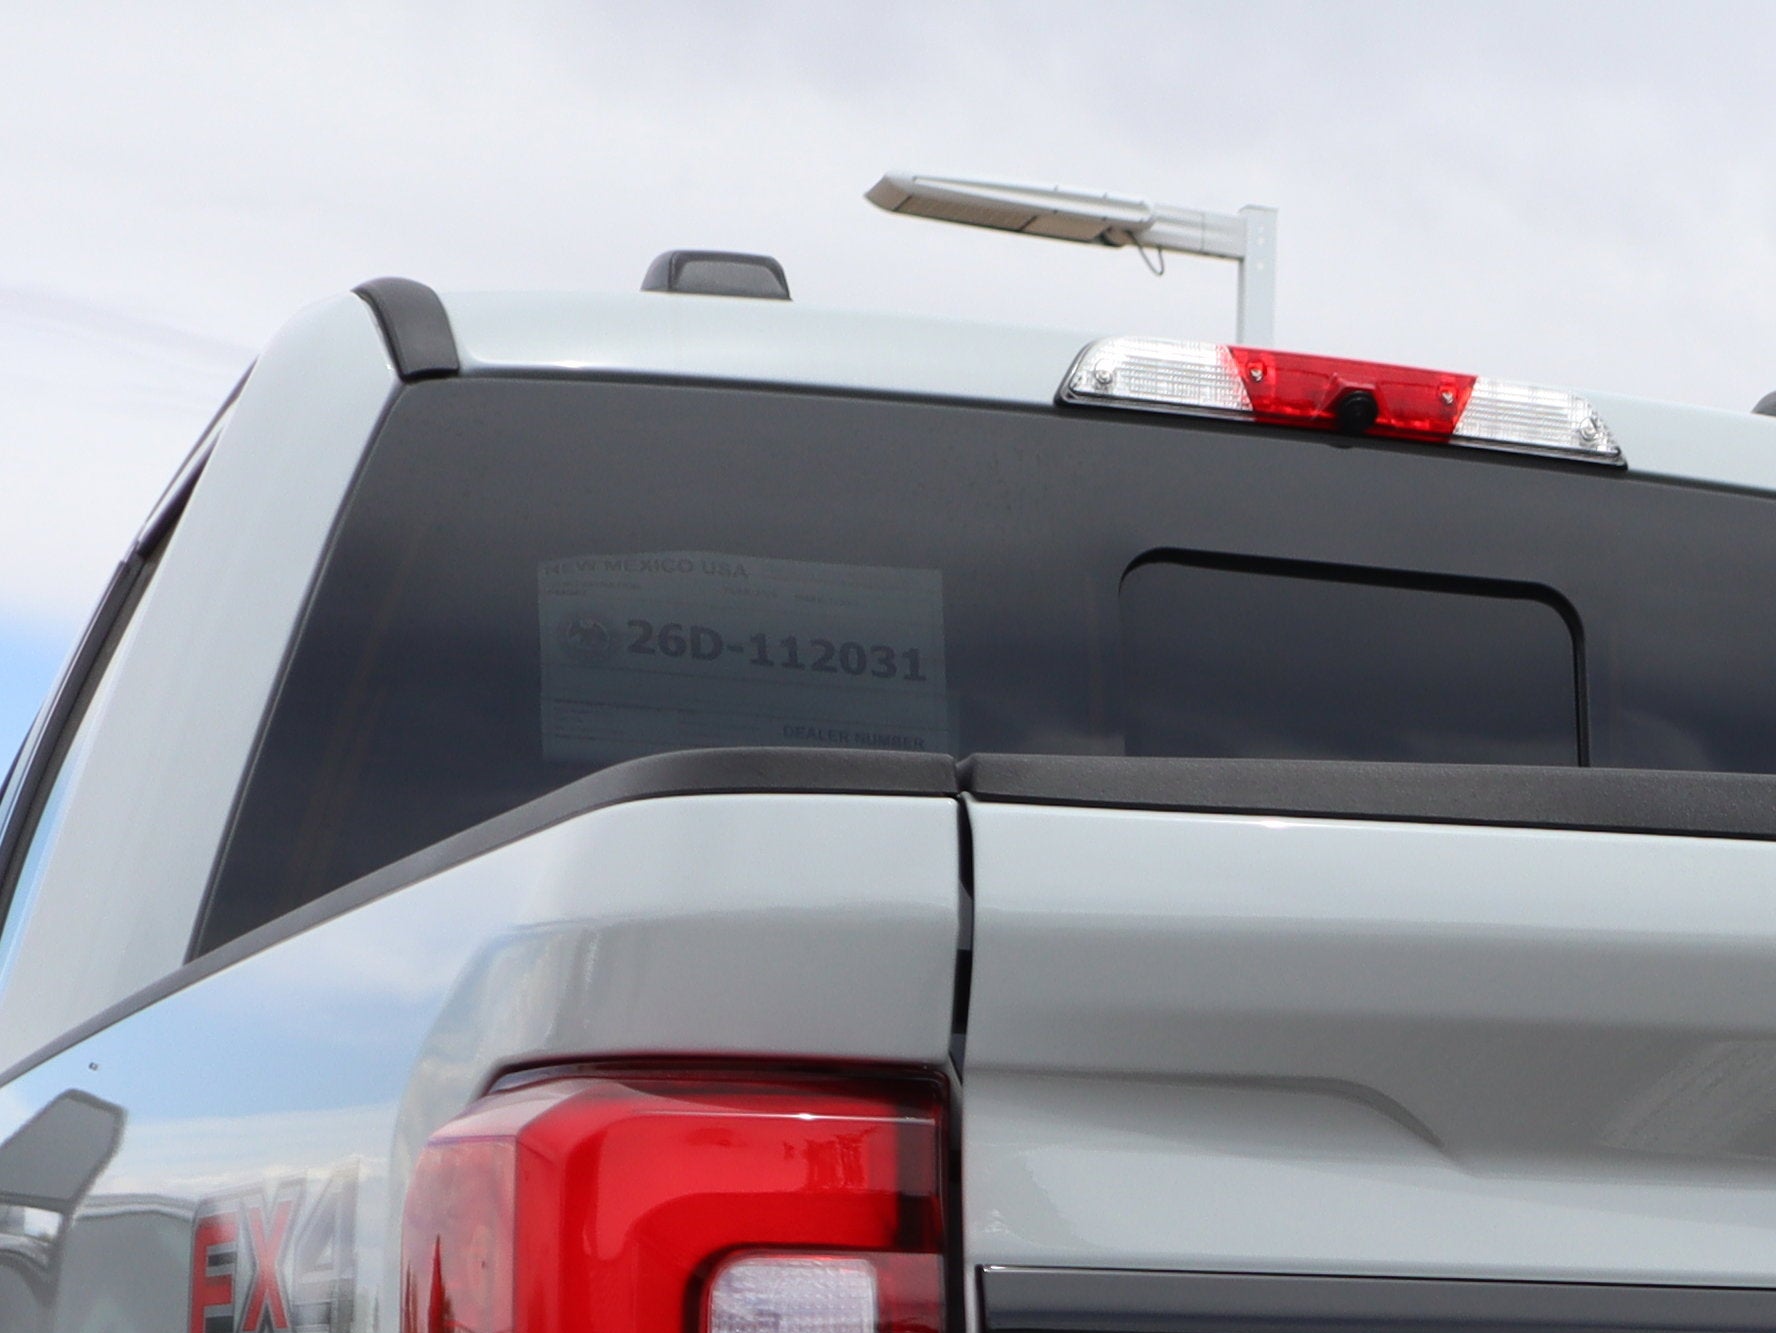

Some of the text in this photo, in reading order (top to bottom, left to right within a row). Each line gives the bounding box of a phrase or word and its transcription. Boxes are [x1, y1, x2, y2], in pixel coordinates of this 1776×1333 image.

[544, 557, 750, 580] NEW MEXICO USA
[626, 619, 927, 682] 26D-112031
[782, 724, 926, 751] DEALER NUMBER
